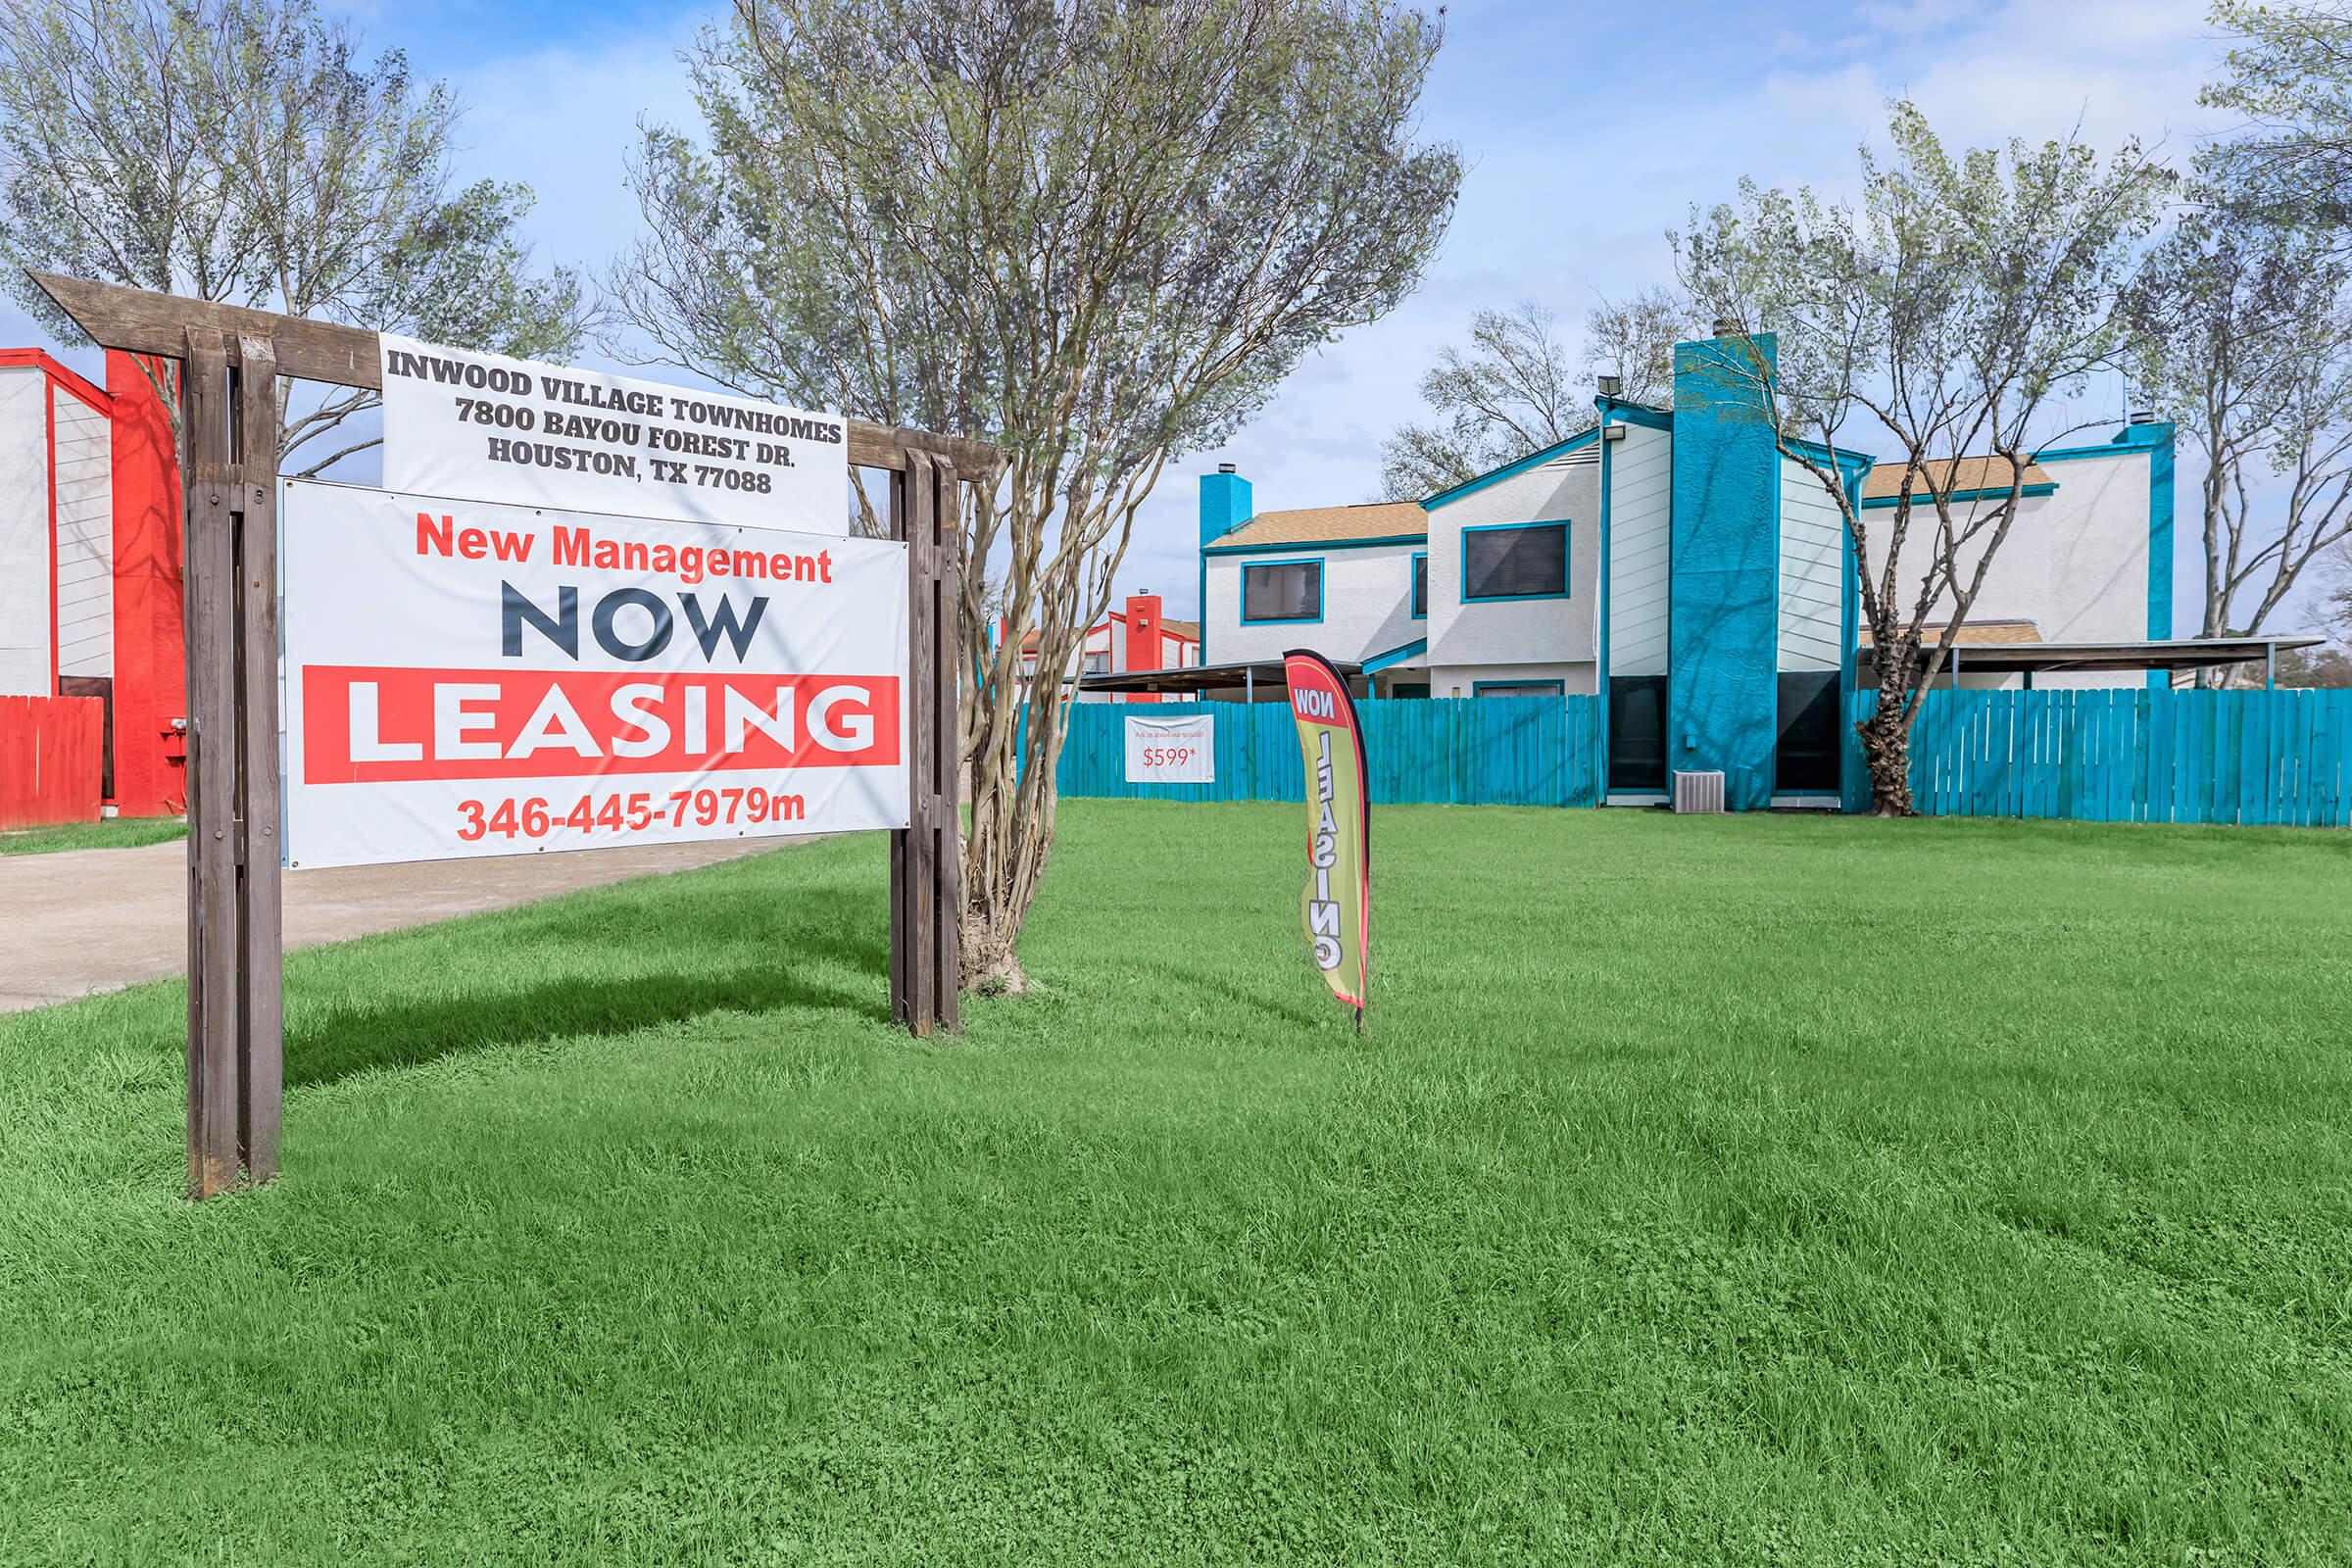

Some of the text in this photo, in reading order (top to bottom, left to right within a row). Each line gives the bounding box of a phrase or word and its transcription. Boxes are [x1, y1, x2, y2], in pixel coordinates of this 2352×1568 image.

[387, 350, 842, 445] INWOOD VILLAGE TOWNHOMES
[456, 398, 796, 468] 7800 BAYOU FOREST DR.
[488, 437, 771, 495] HOUSTON, TX 77088
[416, 513, 832, 584] New Management
[501, 579, 770, 664] NOW
[348, 680, 875, 762] LEASING
[457, 785, 806, 841] 346-445-7979m
